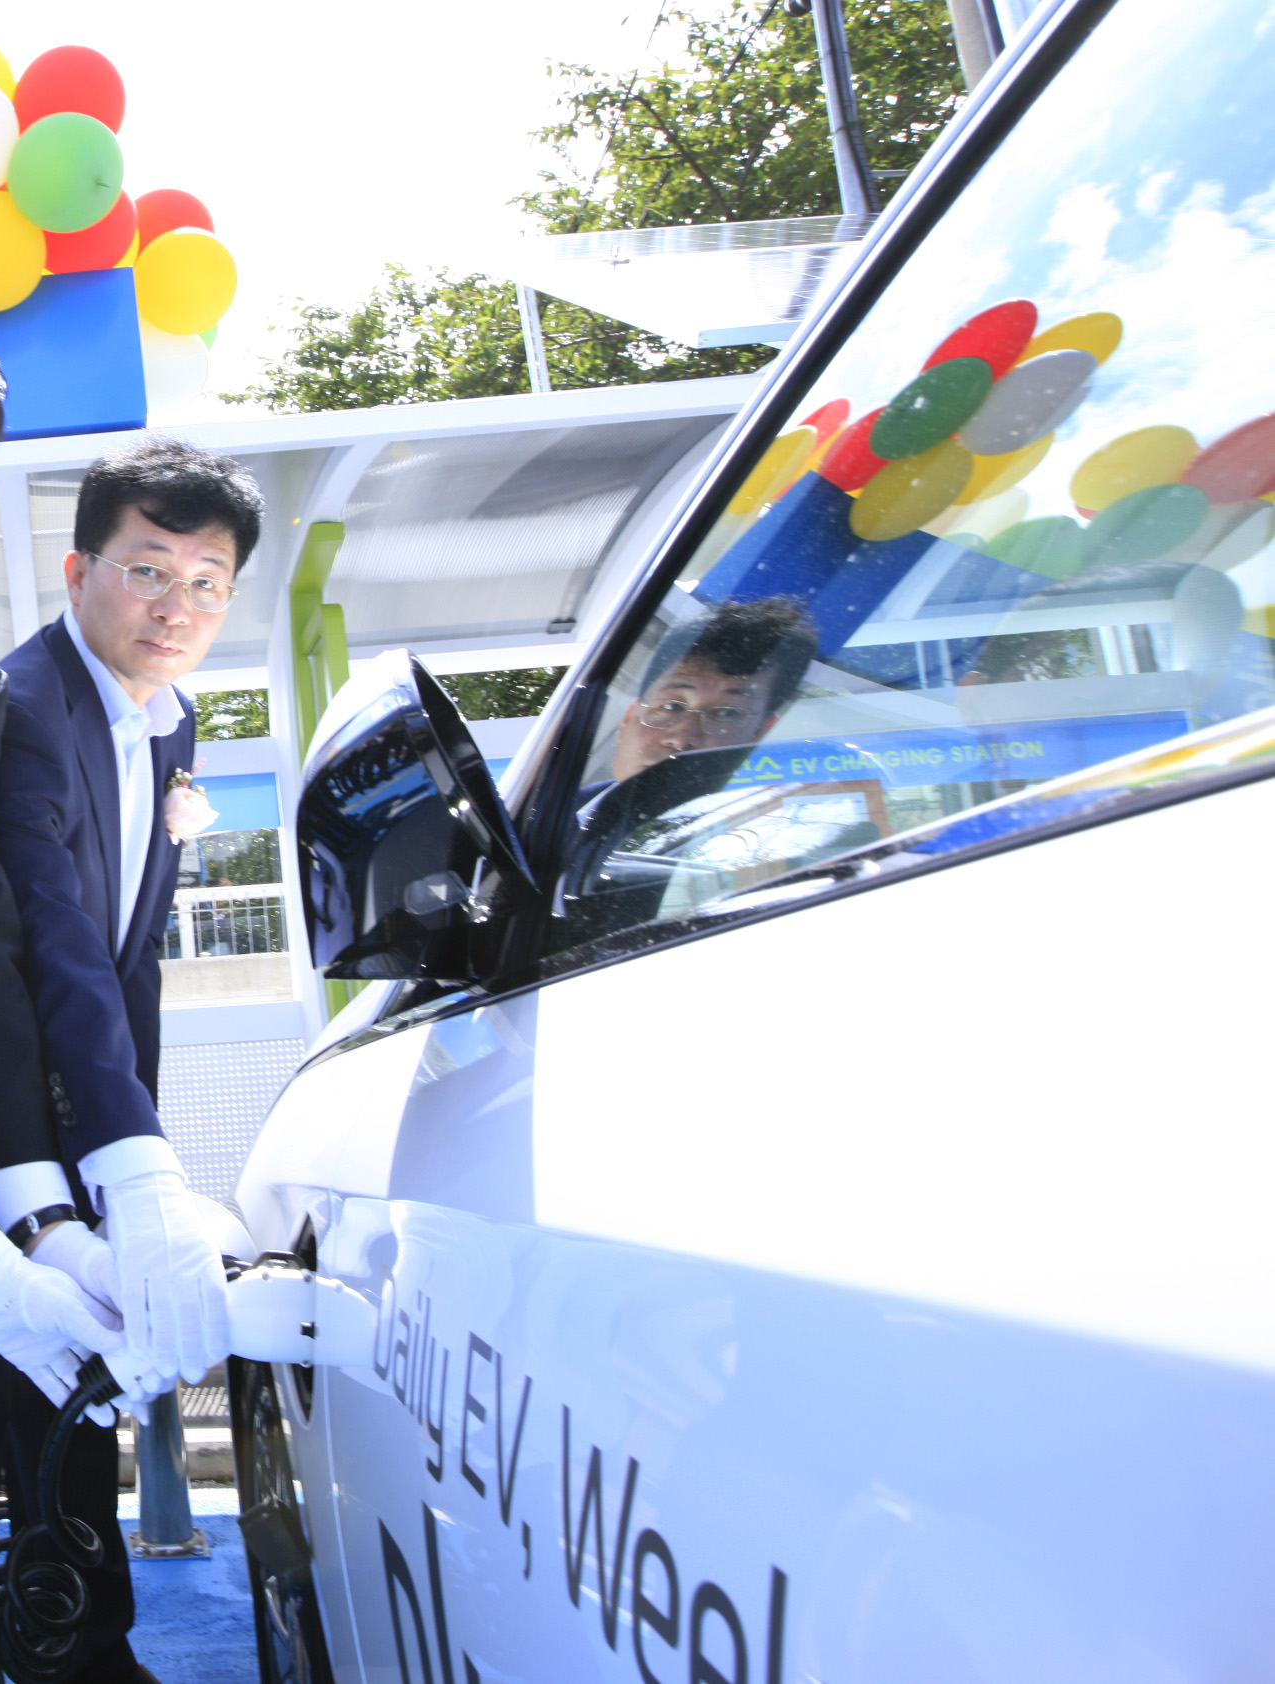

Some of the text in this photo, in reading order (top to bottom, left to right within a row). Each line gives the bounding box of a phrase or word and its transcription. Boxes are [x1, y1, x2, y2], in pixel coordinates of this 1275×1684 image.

[791, 740, 1044, 775] EV CHARGING STATION
